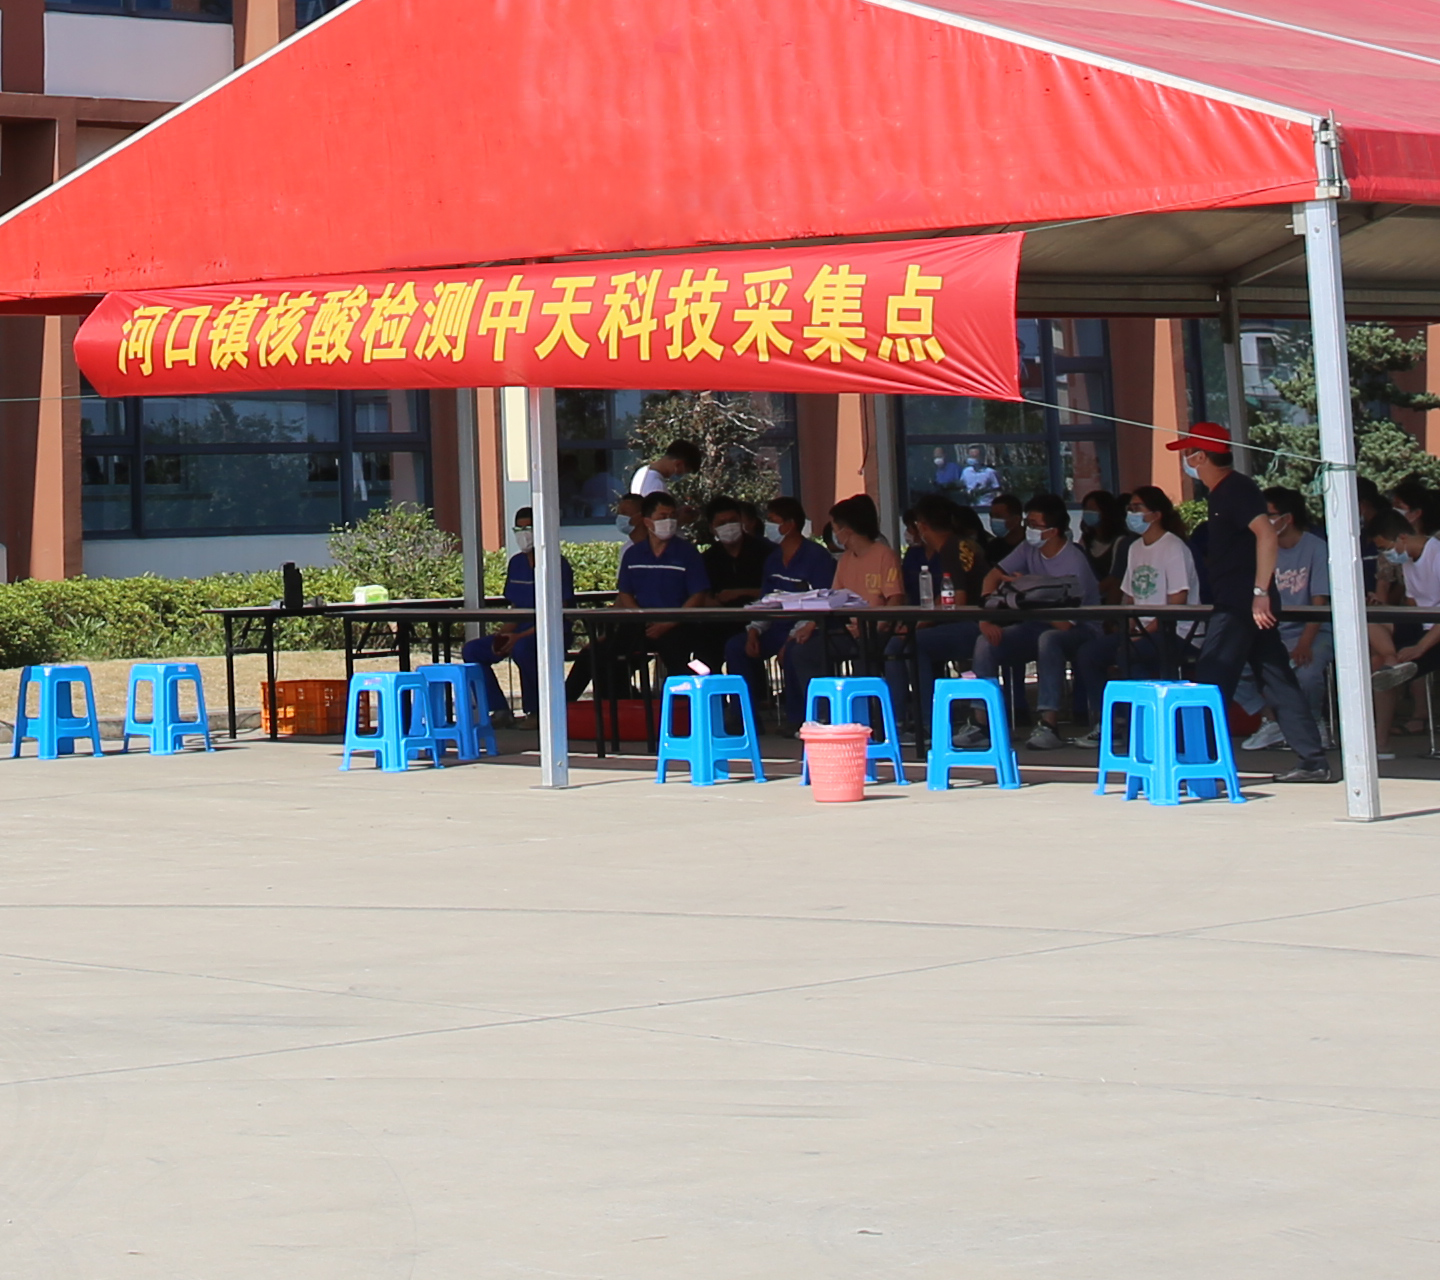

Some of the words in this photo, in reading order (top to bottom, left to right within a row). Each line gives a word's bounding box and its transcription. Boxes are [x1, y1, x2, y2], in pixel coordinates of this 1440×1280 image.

[118, 262, 944, 376] 河口镇核酸检测中天科技采集点
